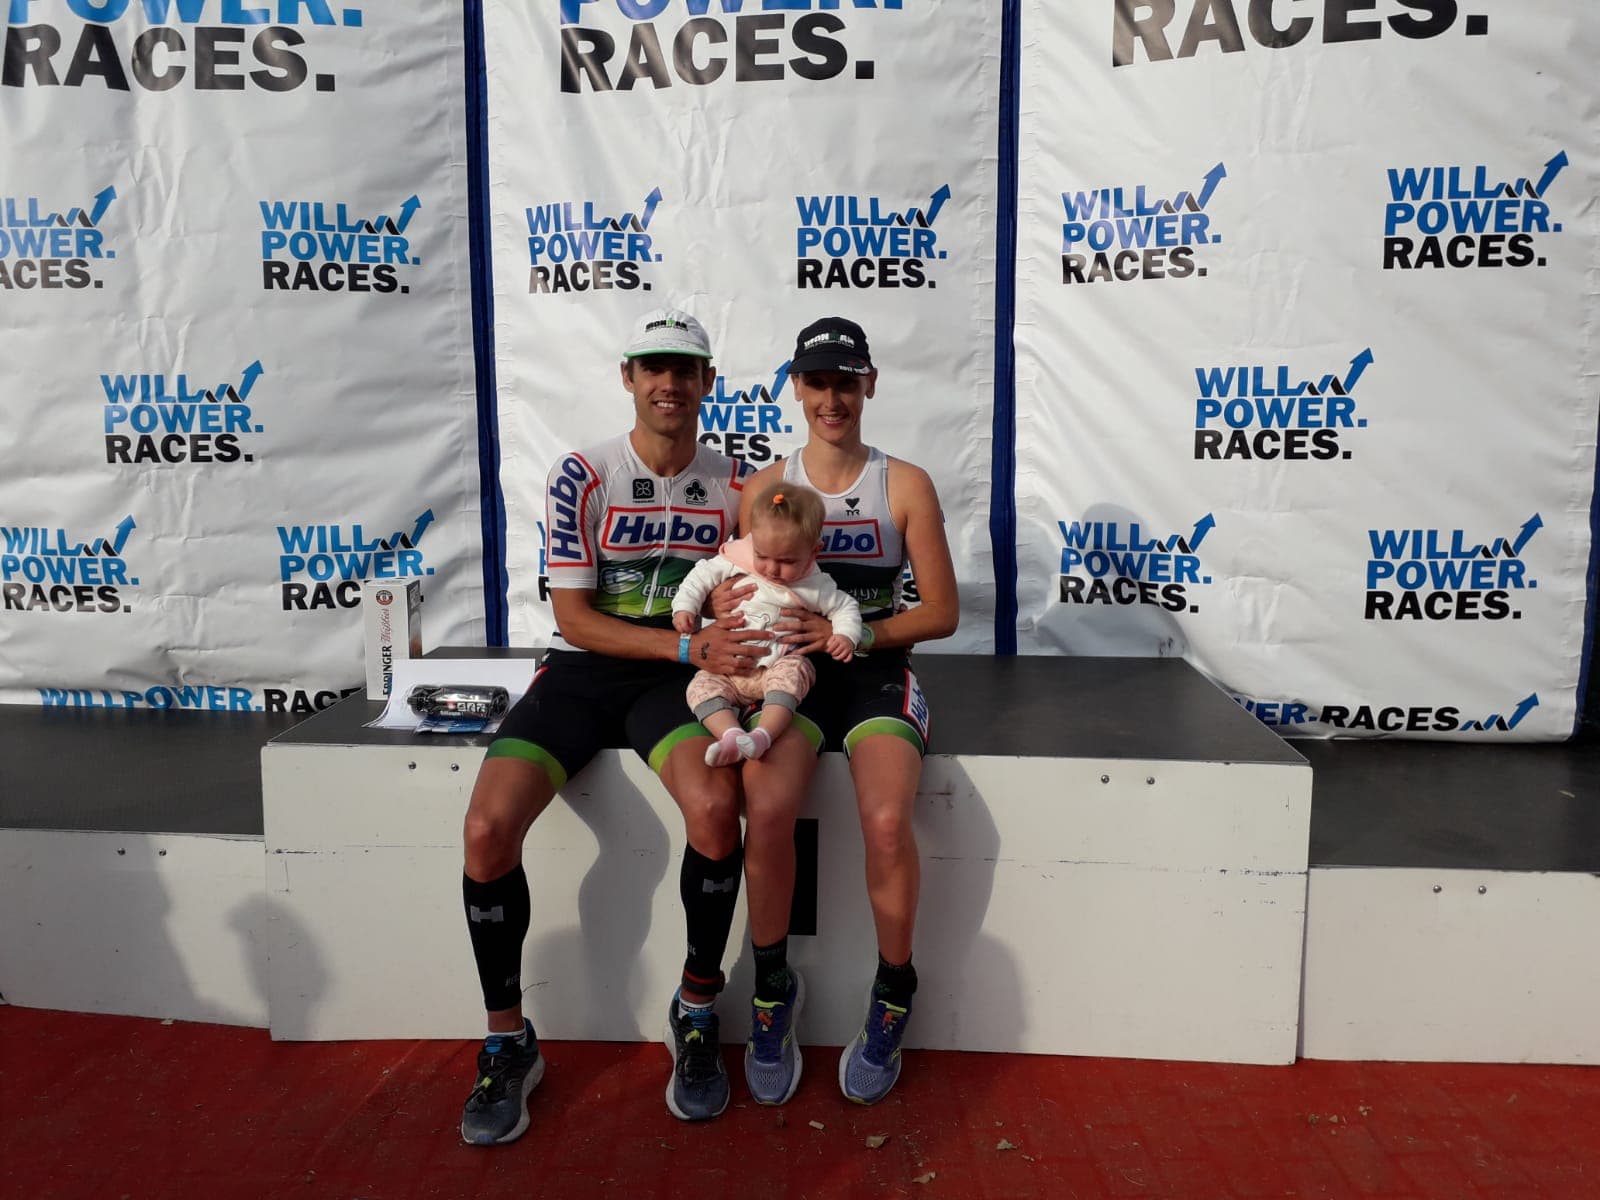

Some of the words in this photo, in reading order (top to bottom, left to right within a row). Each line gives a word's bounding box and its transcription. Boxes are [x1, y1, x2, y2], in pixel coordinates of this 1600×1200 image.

[1113, 0, 1488, 67] RACES.
[2, 24, 336, 92] RACES.
[560, 12, 875, 93] RACES.
[1387, 166, 1507, 201] WILL
[0, 198, 58, 227] LL
[259, 201, 366, 233] WILL
[526, 202, 611, 235] WILL
[796, 196, 898, 226] WILL
[1062, 185, 1165, 221] WILL
[1385, 200, 1562, 236] POWER.
[0, 228, 115, 259] WER.
[261, 231, 421, 265] POWER.
[528, 231, 662, 265] POWER.
[797, 227, 947, 259] POWER.
[1062, 213, 1221, 253] POWER.
[1062, 247, 1207, 284] RACES.
[1383, 234, 1547, 269] RACES.
[0, 259, 103, 289] CES.
[263, 260, 409, 294] RACES.
[529, 260, 651, 294] RACES.
[797, 258, 936, 288] RACES.
[100, 374, 207, 403] WILL
[1195, 366, 1311, 397] WILL
[104, 404, 264, 433] POWER.
[699, 404, 792, 433] WER.
[1195, 397, 1367, 428] POWER.
[105, 434, 253, 463] RACES.
[699, 433, 782, 462] CES.
[1194, 429, 1352, 460] RACES.
[550, 457, 587, 560] Hubo
[0, 527, 84, 556] WILL
[277, 525, 382, 553] WILL
[608, 515, 718, 545] Hubo
[821, 528, 875, 552] bo
[1058, 521, 1158, 552] WILL
[1368, 530, 1483, 559] WILL
[2, 554, 139, 585] POWER.
[280, 550, 434, 582] POWER.
[1061, 548, 1211, 584] POWER.
[1367, 559, 1537, 590] POWER.
[3, 582, 131, 613] RACES.
[282, 581, 361, 610] RAC
[1060, 576, 1199, 613] RACES.
[1365, 590, 1521, 620] RACES.
